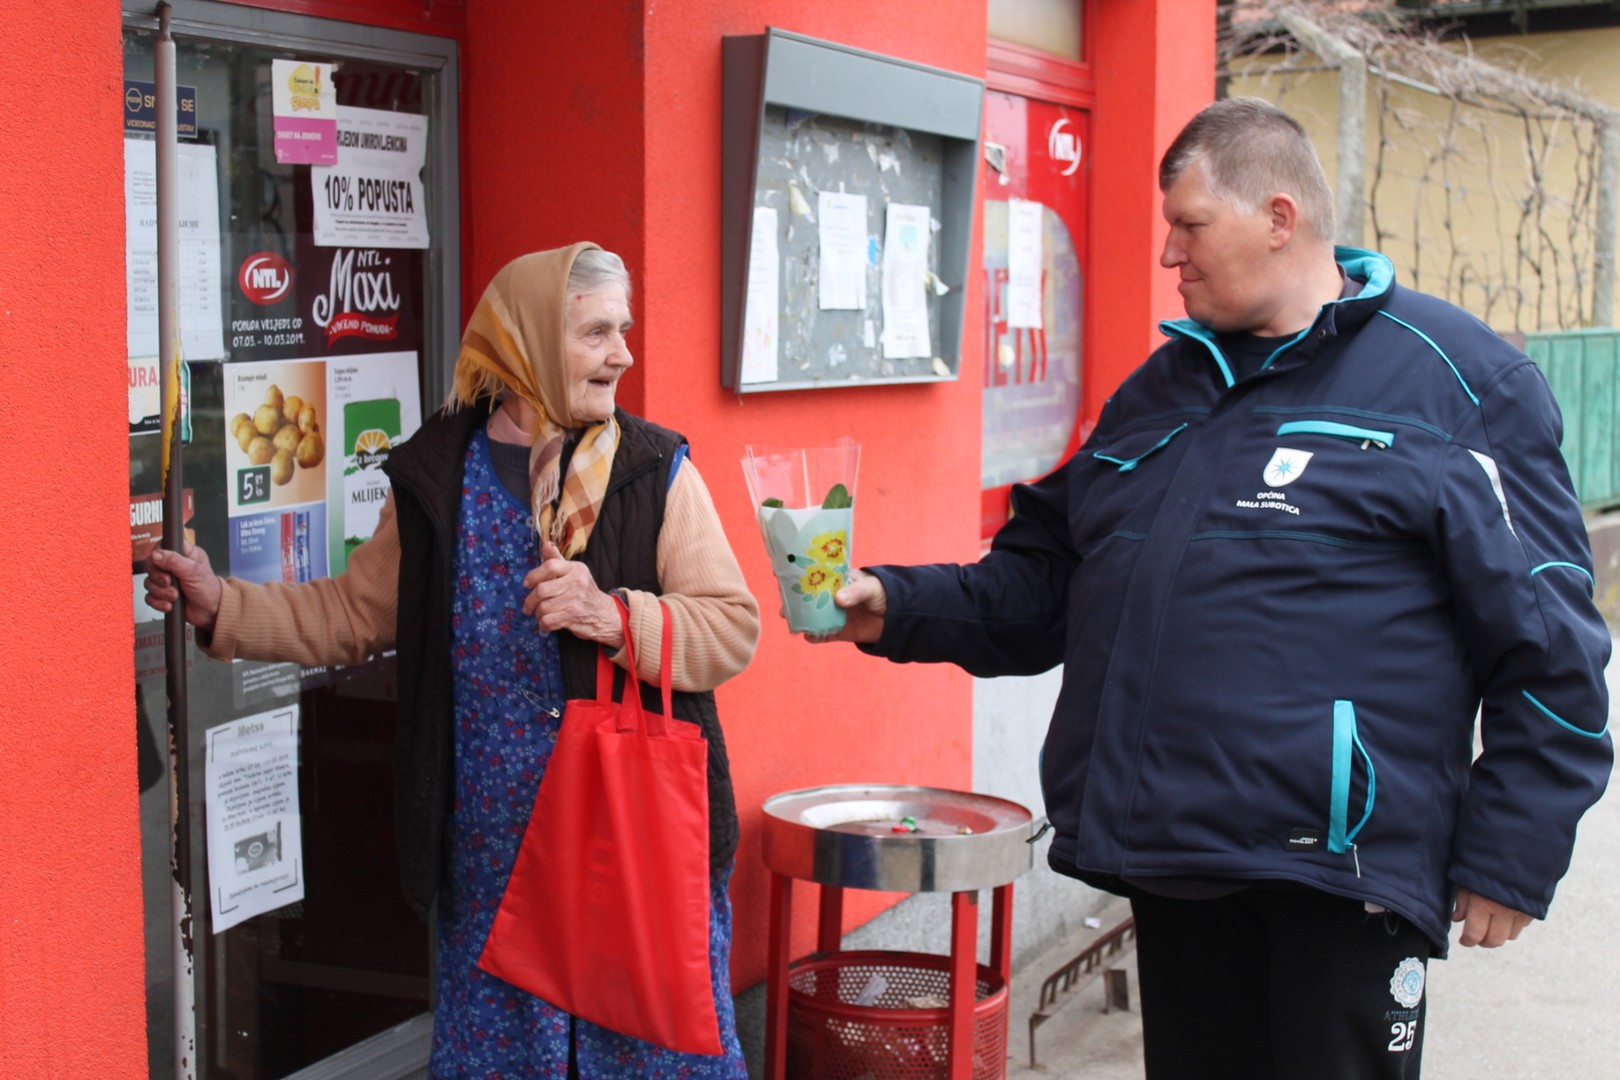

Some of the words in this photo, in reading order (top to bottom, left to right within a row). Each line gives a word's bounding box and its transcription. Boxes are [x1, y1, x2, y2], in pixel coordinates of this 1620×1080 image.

[181, 98, 194, 112] SE
[336, 130, 360, 149] RIJEDOM
[324, 174, 354, 212] 10%
[358, 177, 415, 214] POPUSTA
[356, 250, 382, 267] NTL
[252, 268, 282, 289] NTL
[312, 248, 400, 328] Maxi
[232, 319, 260, 332] PONUDA
[261, 318, 291, 331] VRIJEDI
[292, 317, 303, 329] OD
[129, 366, 159, 388] URA
[243, 472, 255, 500] 5
[352, 486, 387, 504] MLIJEK
[1256, 490, 1286, 501] OPĆINA
[130, 499, 163, 527] GURNI
[1236, 499, 1260, 509] MALA
[1260, 501, 1300, 516] SUBOTICA
[237, 722, 265, 738] Metss
[1387, 1020, 1417, 1052] 25
